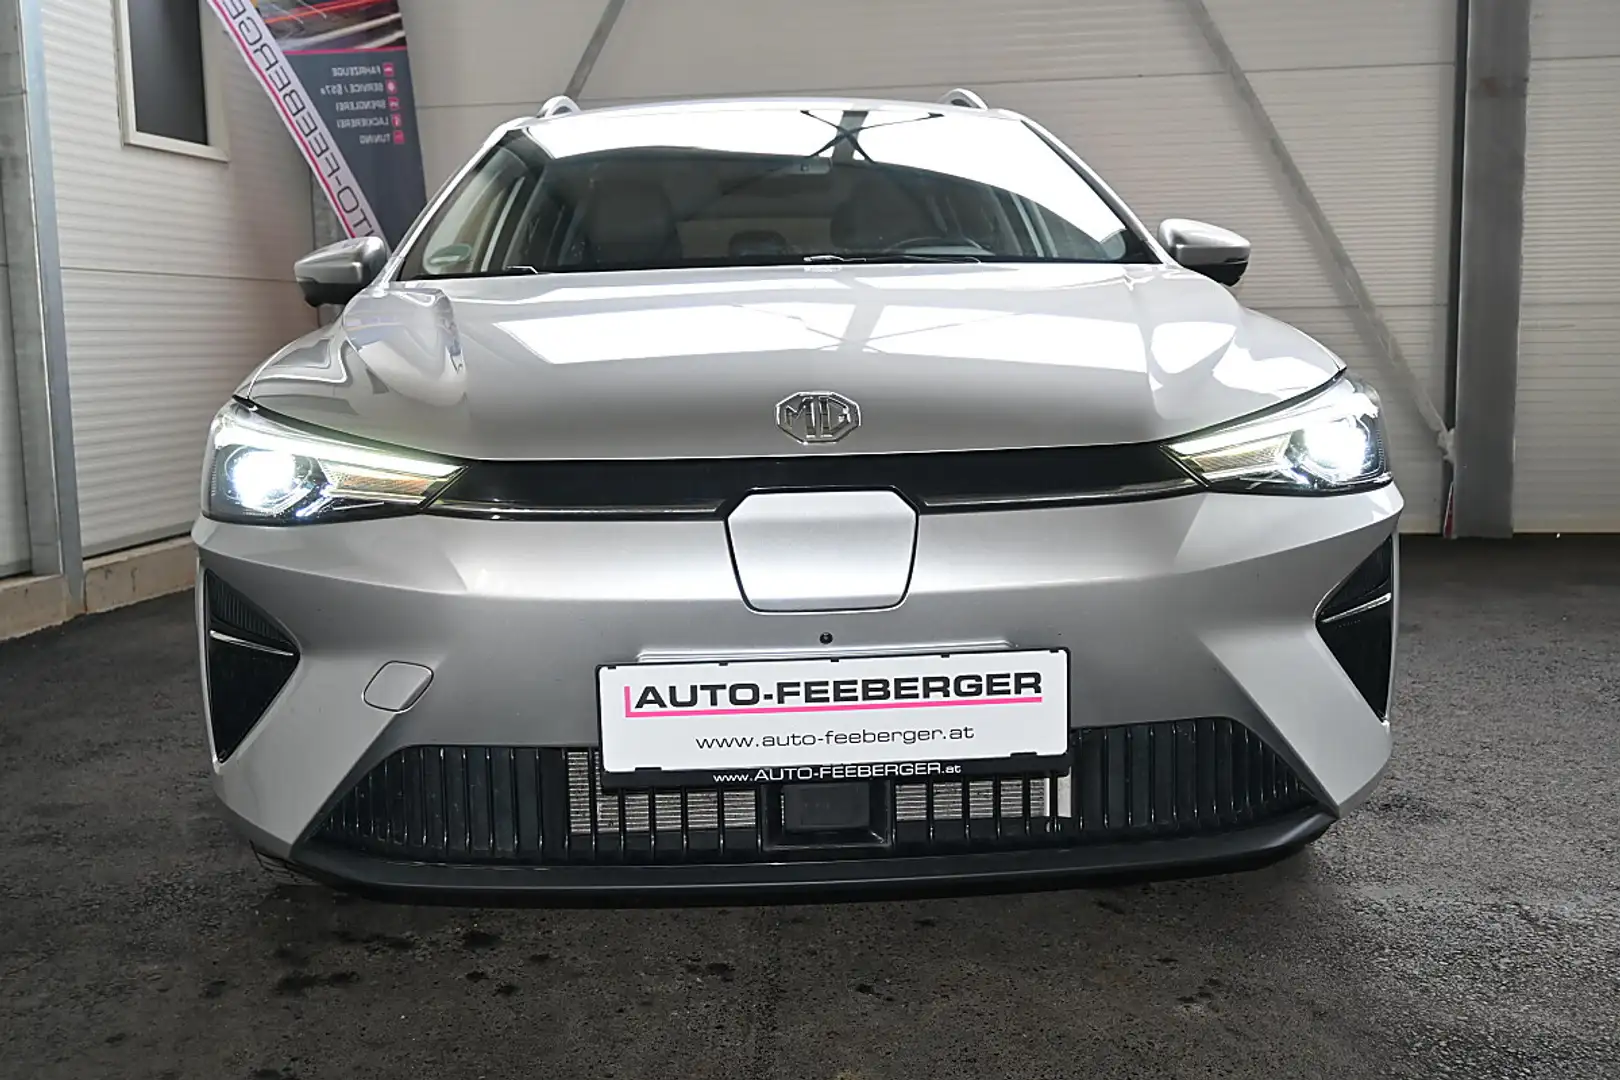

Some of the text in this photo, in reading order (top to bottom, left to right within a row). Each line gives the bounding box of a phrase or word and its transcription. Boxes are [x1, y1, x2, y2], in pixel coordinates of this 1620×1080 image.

[784, 397, 851, 438] MG
[634, 671, 1042, 709] AUTO-FEEBERGER
[695, 725, 975, 751] www.auto-feeberger.at
[712, 763, 962, 784] www.AUTO-FEEBERGER.at
